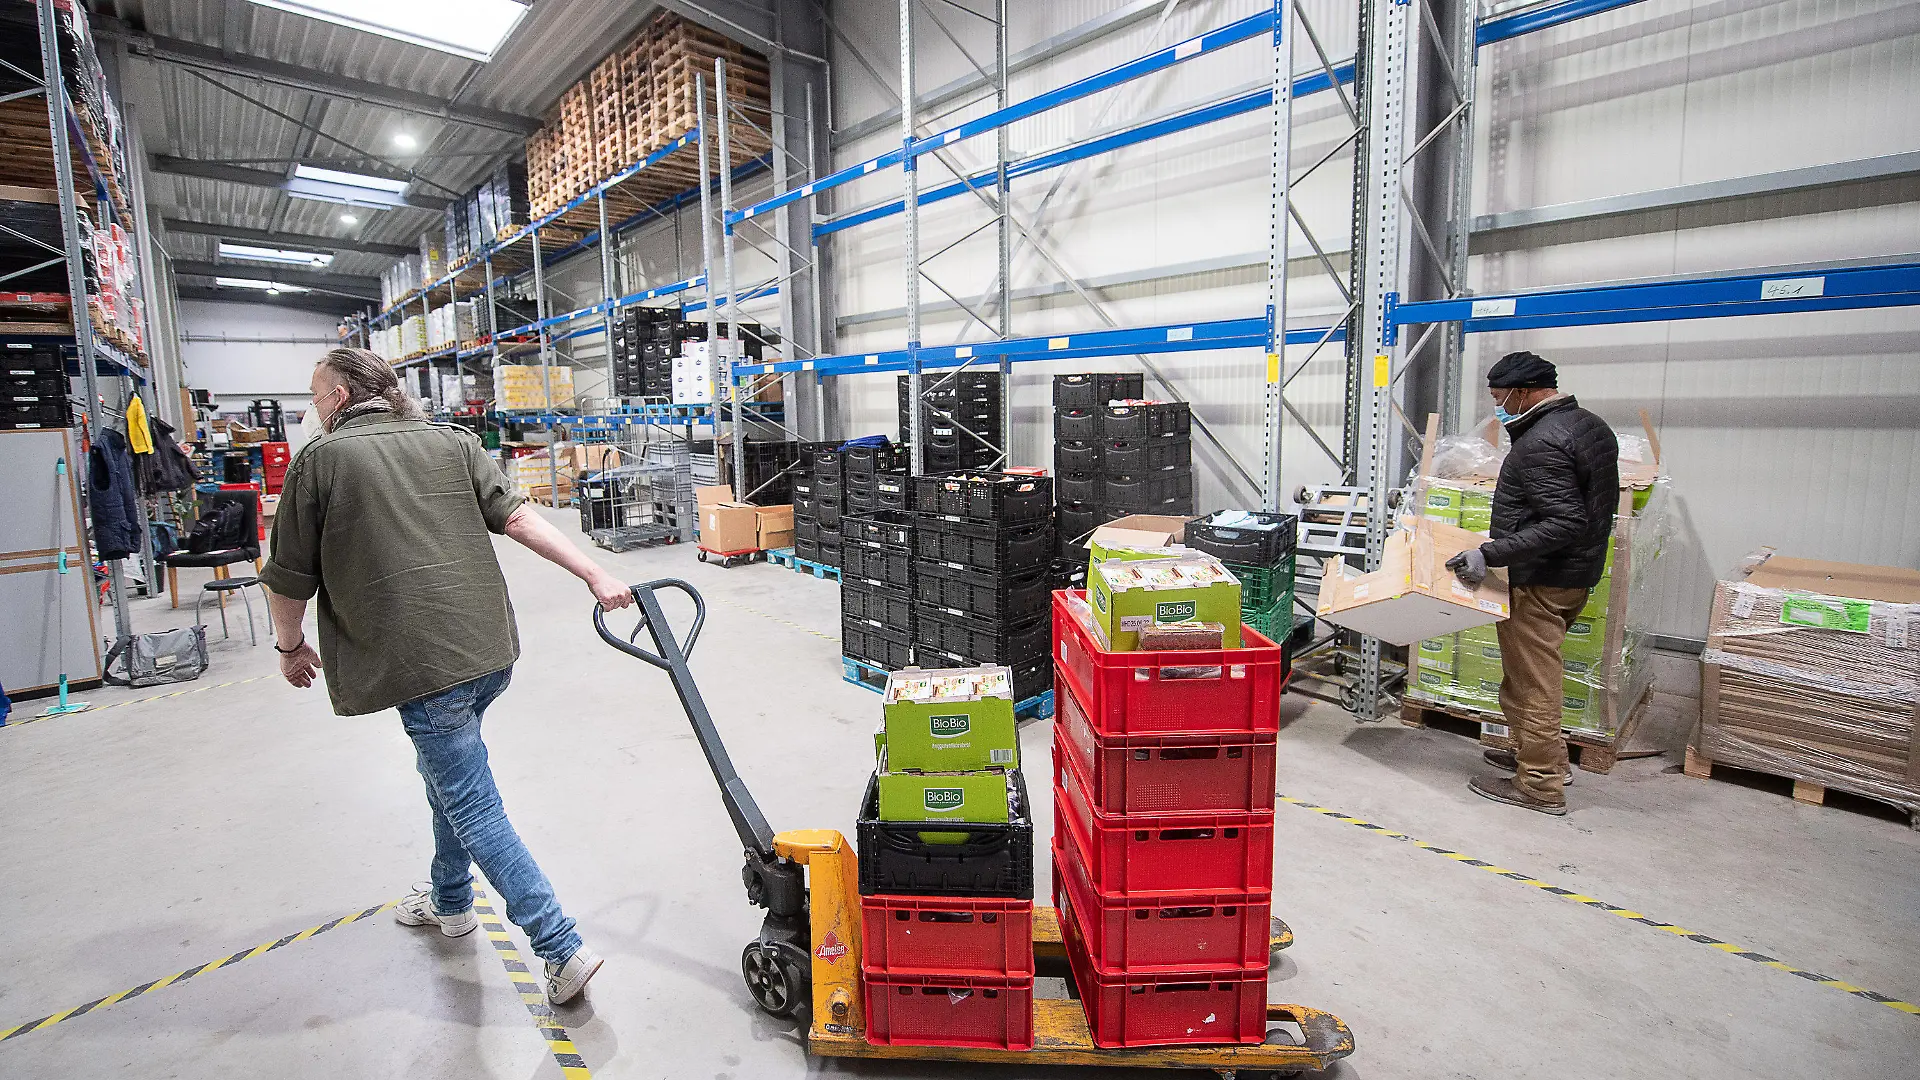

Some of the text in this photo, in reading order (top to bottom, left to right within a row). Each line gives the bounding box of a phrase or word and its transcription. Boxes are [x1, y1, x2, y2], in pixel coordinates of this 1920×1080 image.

[1159, 605, 1193, 616] BioBio
[933, 718, 967, 729] BioBio
[927, 791, 961, 802] BioBio
